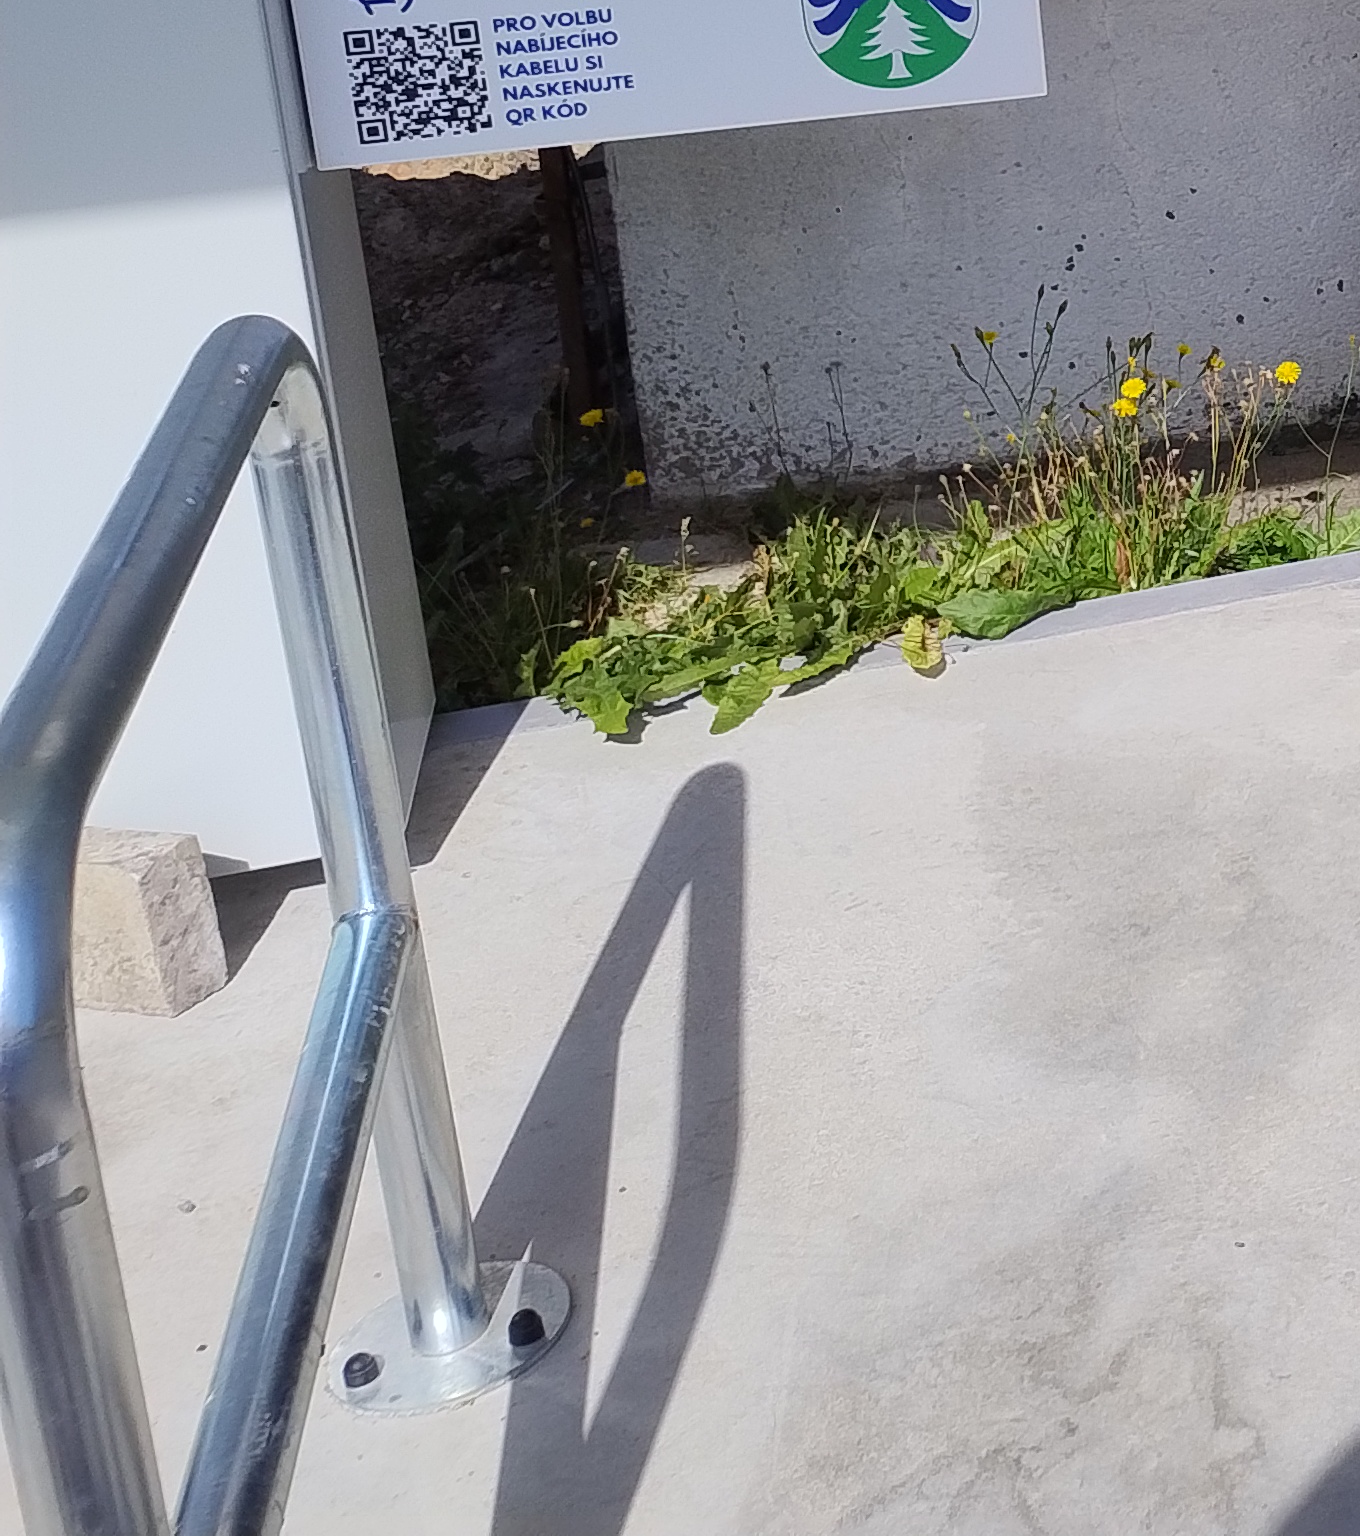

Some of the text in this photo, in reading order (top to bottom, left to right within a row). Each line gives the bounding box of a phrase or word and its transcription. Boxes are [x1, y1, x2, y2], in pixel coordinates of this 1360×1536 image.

[493, 9, 611, 33] PRO VOLBU
[494, 29, 619, 57] NABÍJECÍHO
[499, 56, 603, 78] KABELU SI
[503, 75, 634, 102] NASKENUJTE
[506, 99, 587, 126] QR KÓD
